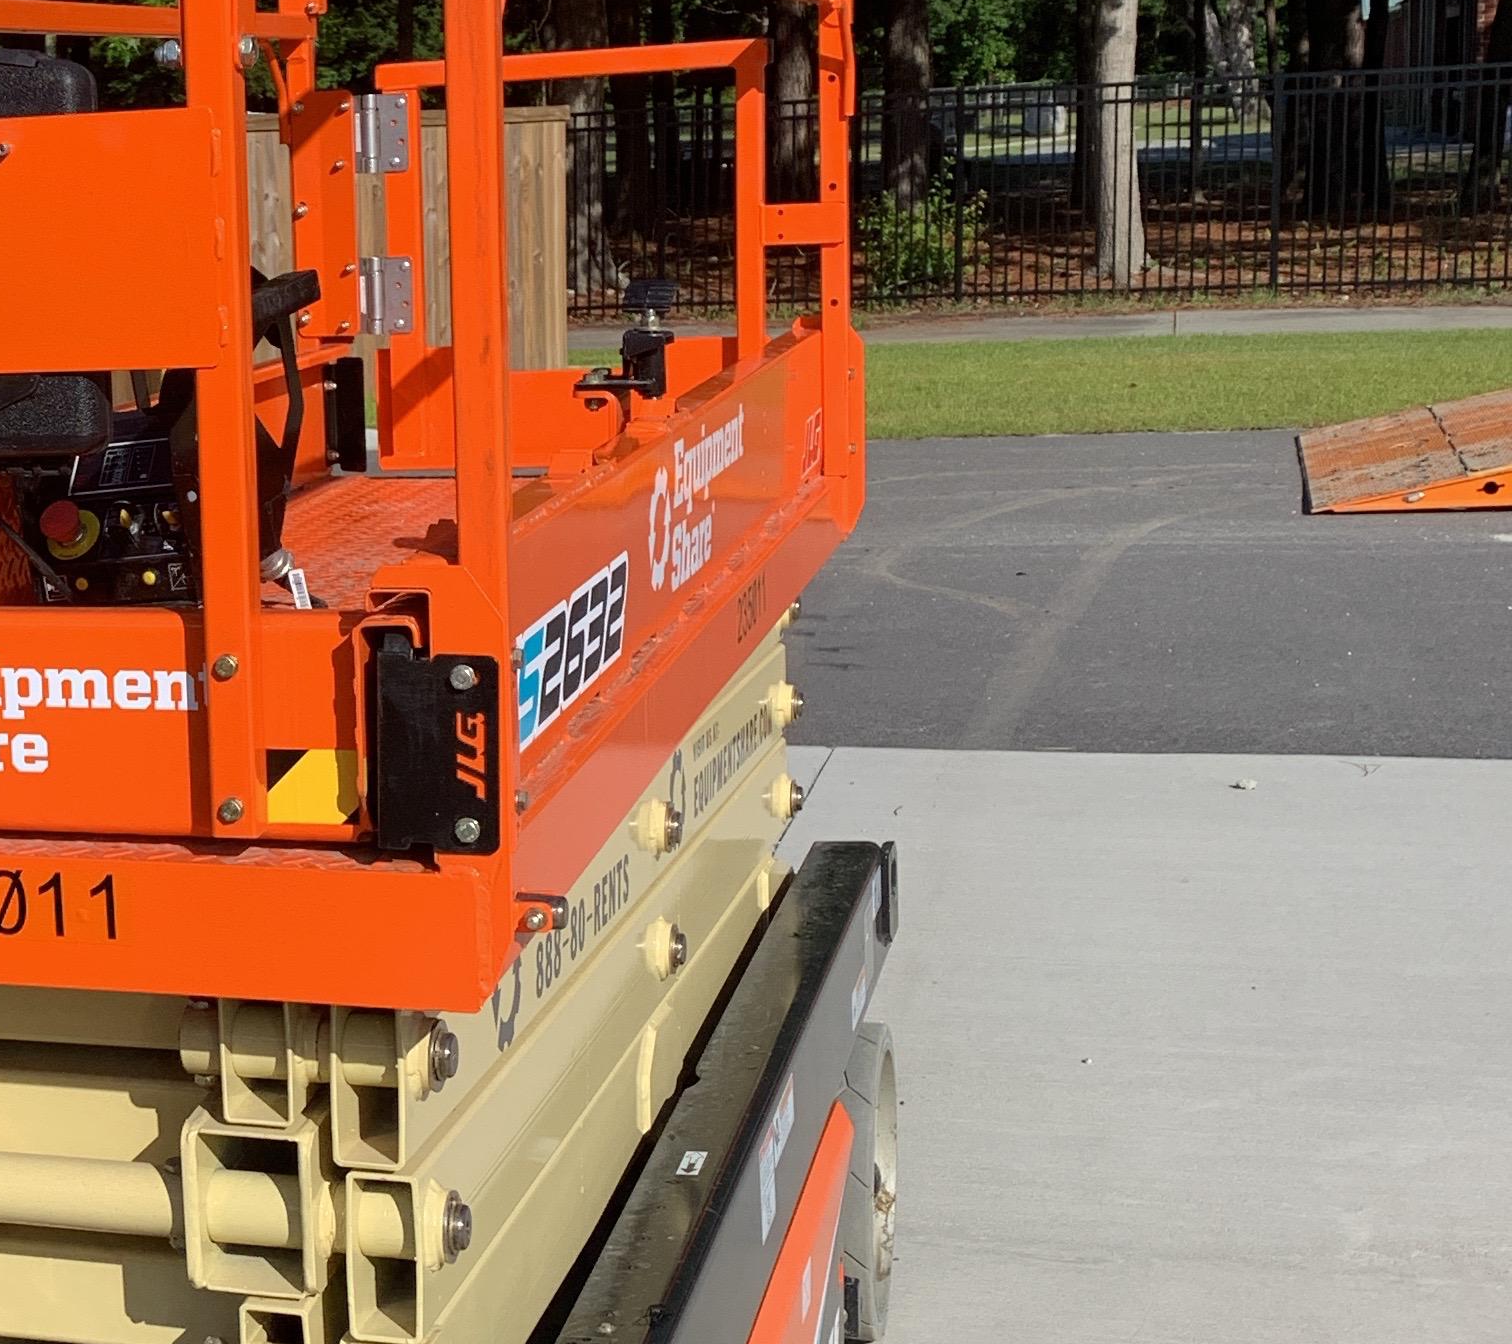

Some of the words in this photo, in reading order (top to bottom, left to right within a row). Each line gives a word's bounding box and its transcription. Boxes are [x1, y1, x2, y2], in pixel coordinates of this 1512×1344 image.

[673, 403, 745, 515] Equipment
[672, 513, 713, 593] Share
[518, 551, 629, 754] S2632
[455, 711, 486, 801] JLG
[535, 853, 630, 999] 888-80-RENTS
